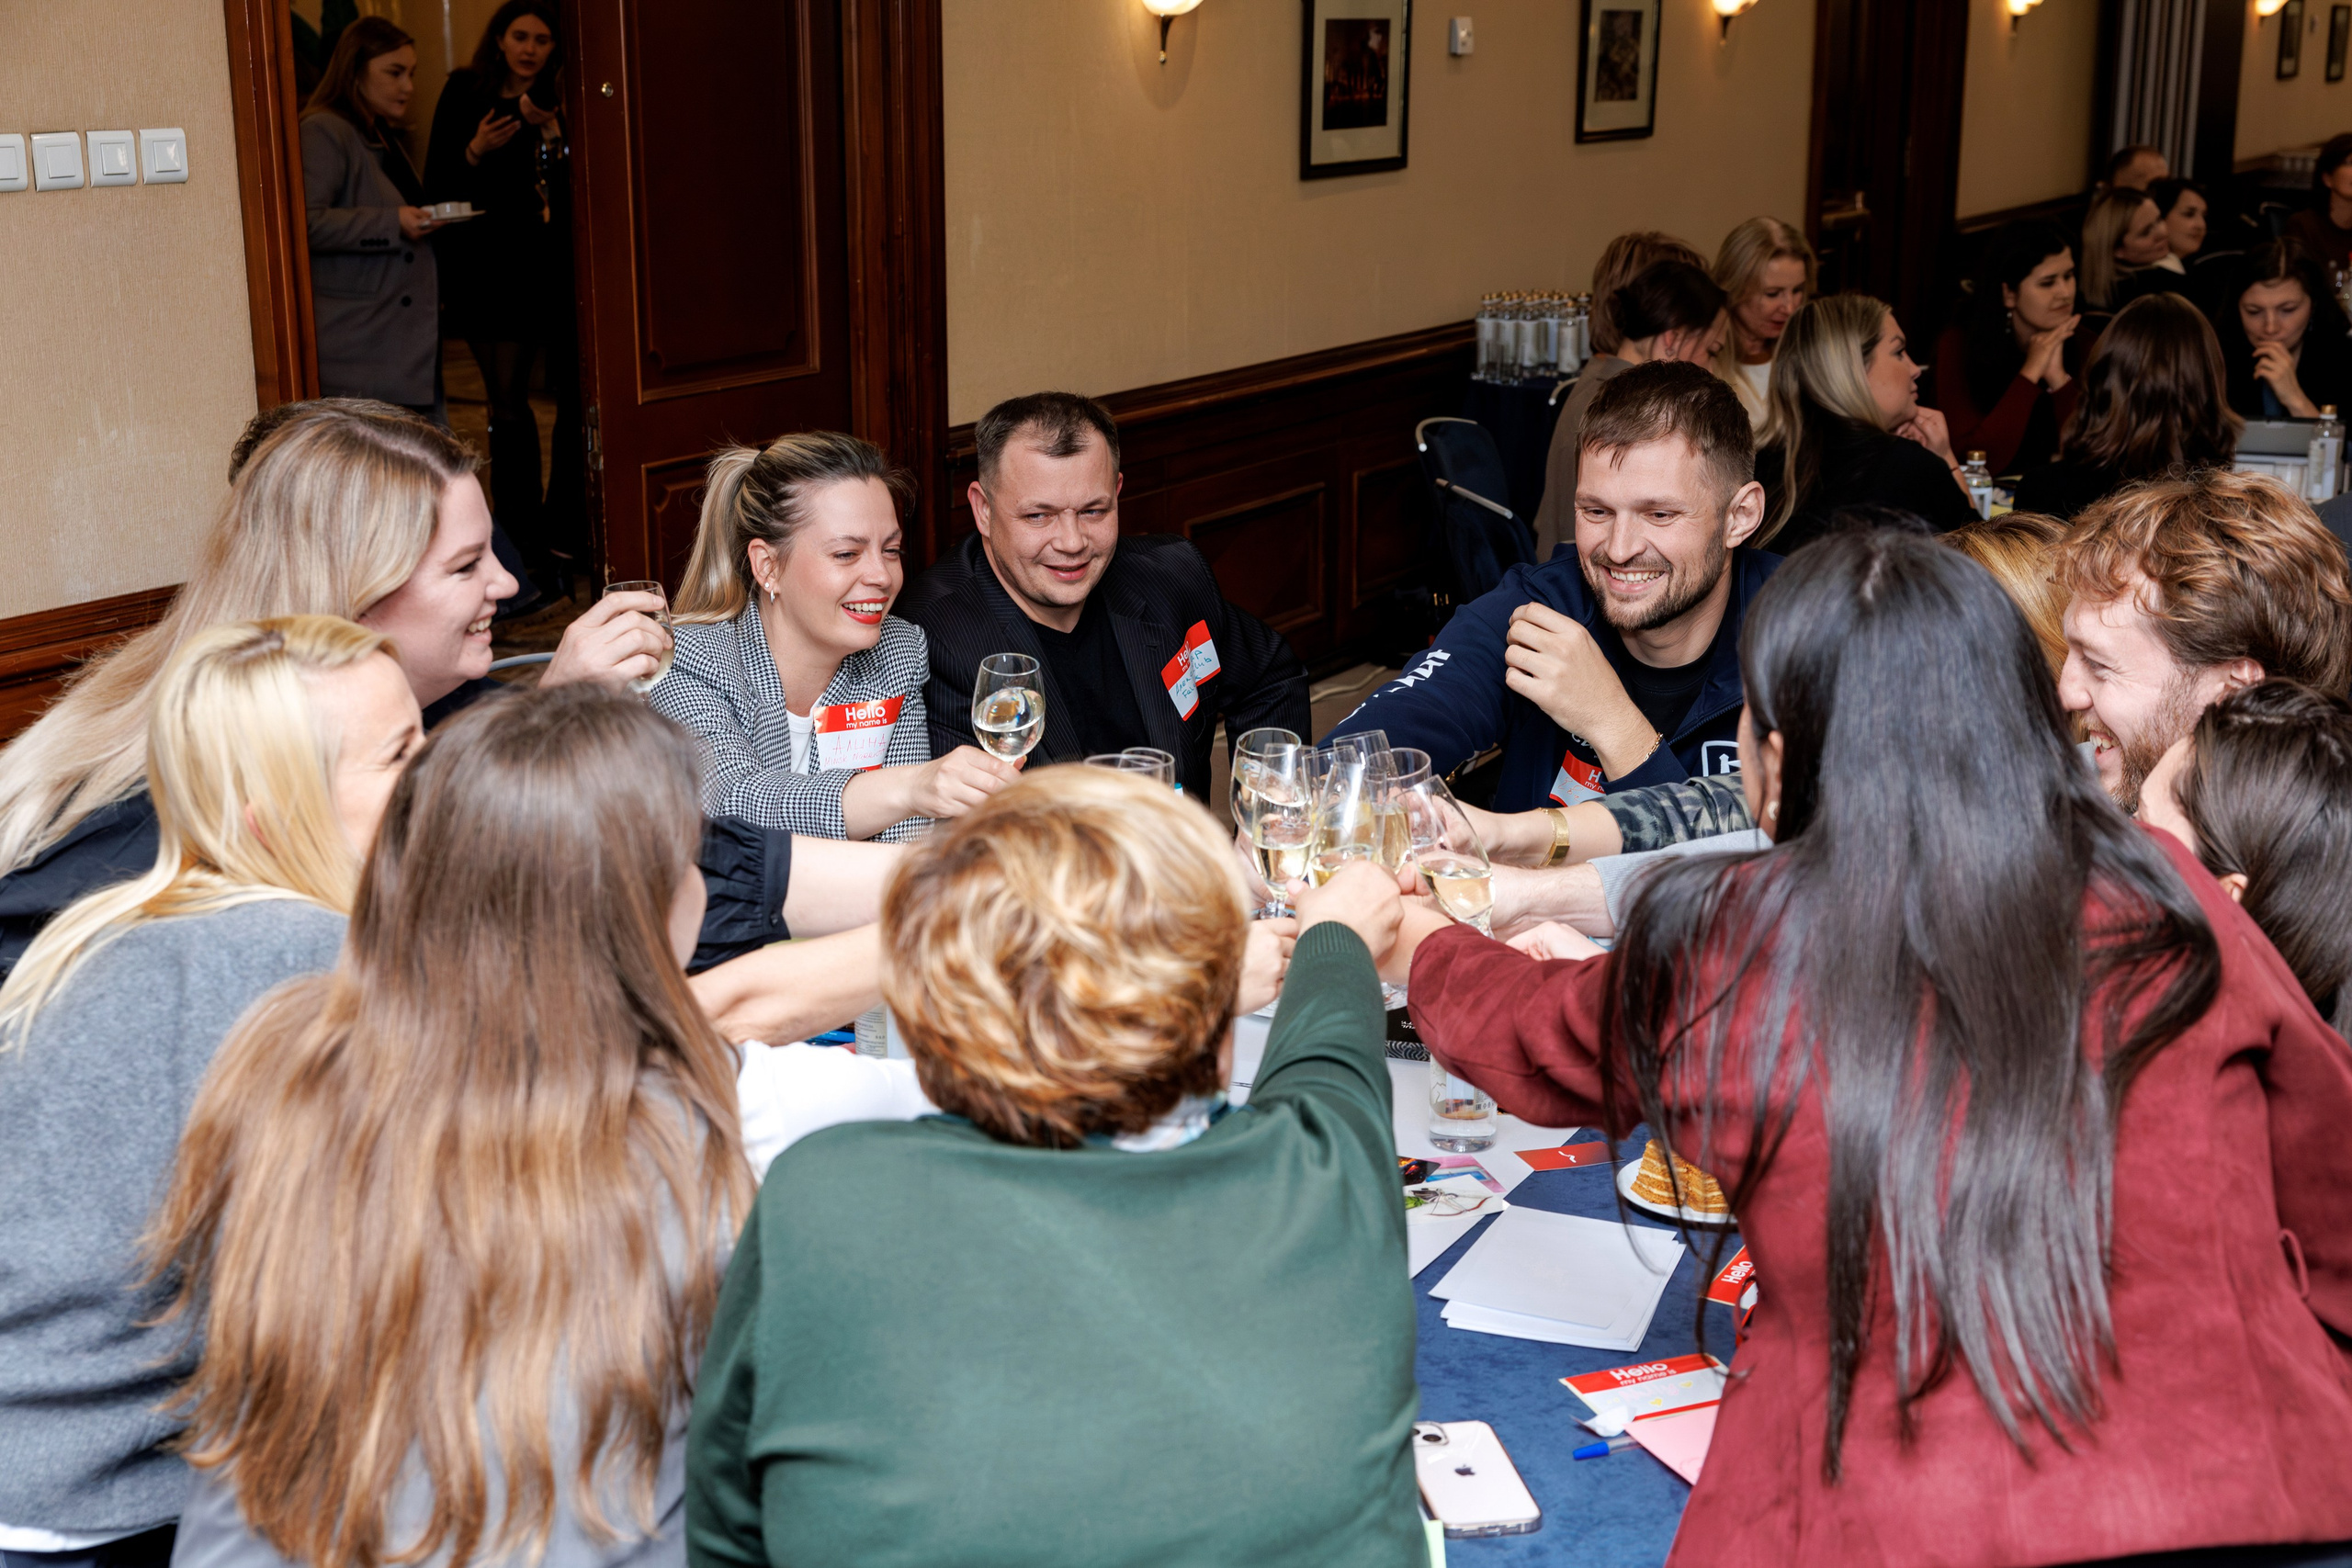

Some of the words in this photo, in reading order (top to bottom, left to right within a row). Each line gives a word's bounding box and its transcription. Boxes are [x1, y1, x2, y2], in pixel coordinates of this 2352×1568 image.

[845, 705, 886, 722] Hello
[859, 719, 880, 728] name
[1585, 781, 1596, 790] my
[1721, 1261, 1753, 1284] Hello
[1610, 1362, 1668, 1382] Hello
[1620, 1379, 1636, 1387] my
[1638, 1372, 1668, 1383] name
